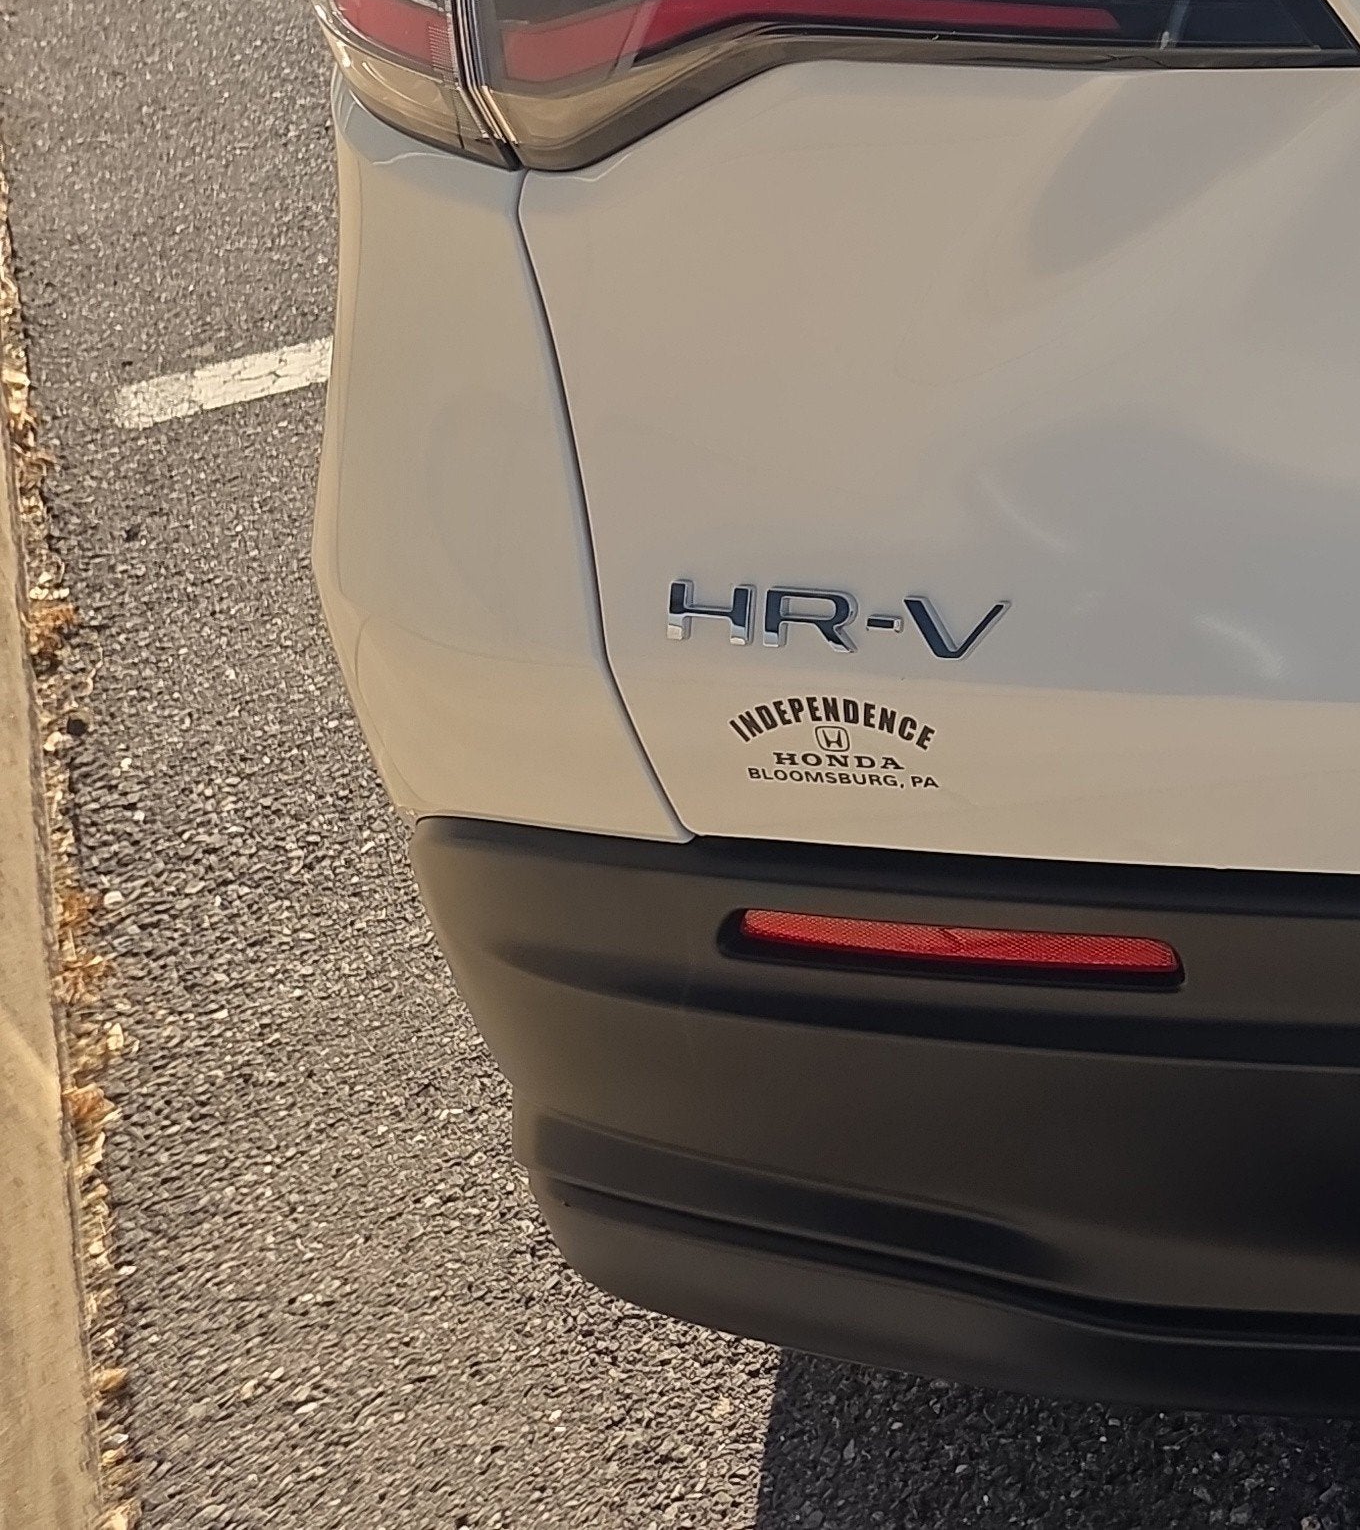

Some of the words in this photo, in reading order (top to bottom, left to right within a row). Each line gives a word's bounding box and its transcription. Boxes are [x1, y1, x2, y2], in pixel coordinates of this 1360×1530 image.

[667, 579, 1011, 661] HR-V
[729, 696, 936, 750] INDEPENDENCE
[748, 768, 905, 789] BLOOMSBURG,
[911, 776, 939, 789] PA
[773, 752, 905, 770] HONDA
